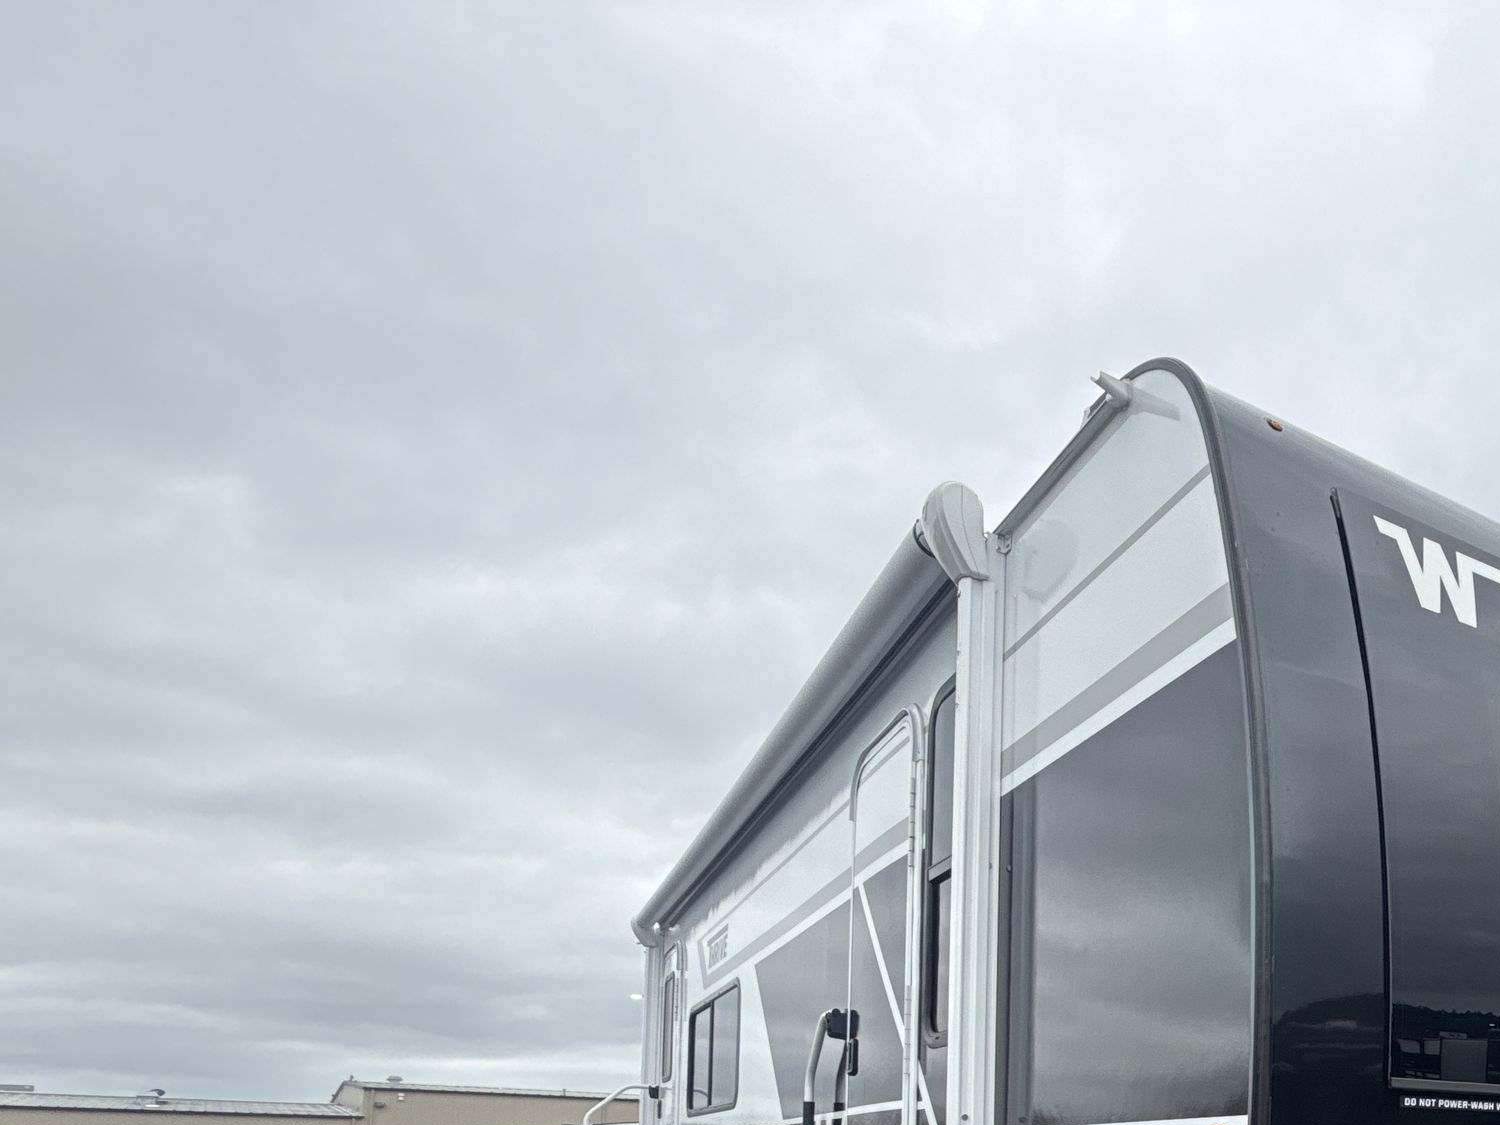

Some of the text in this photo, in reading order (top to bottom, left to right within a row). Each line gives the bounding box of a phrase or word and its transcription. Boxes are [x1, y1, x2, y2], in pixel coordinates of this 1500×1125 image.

[1404, 1097, 1416, 1106] DO
[1419, 1098, 1436, 1108] NOT
[1438, 1099, 1494, 1111] POWER-WASH
